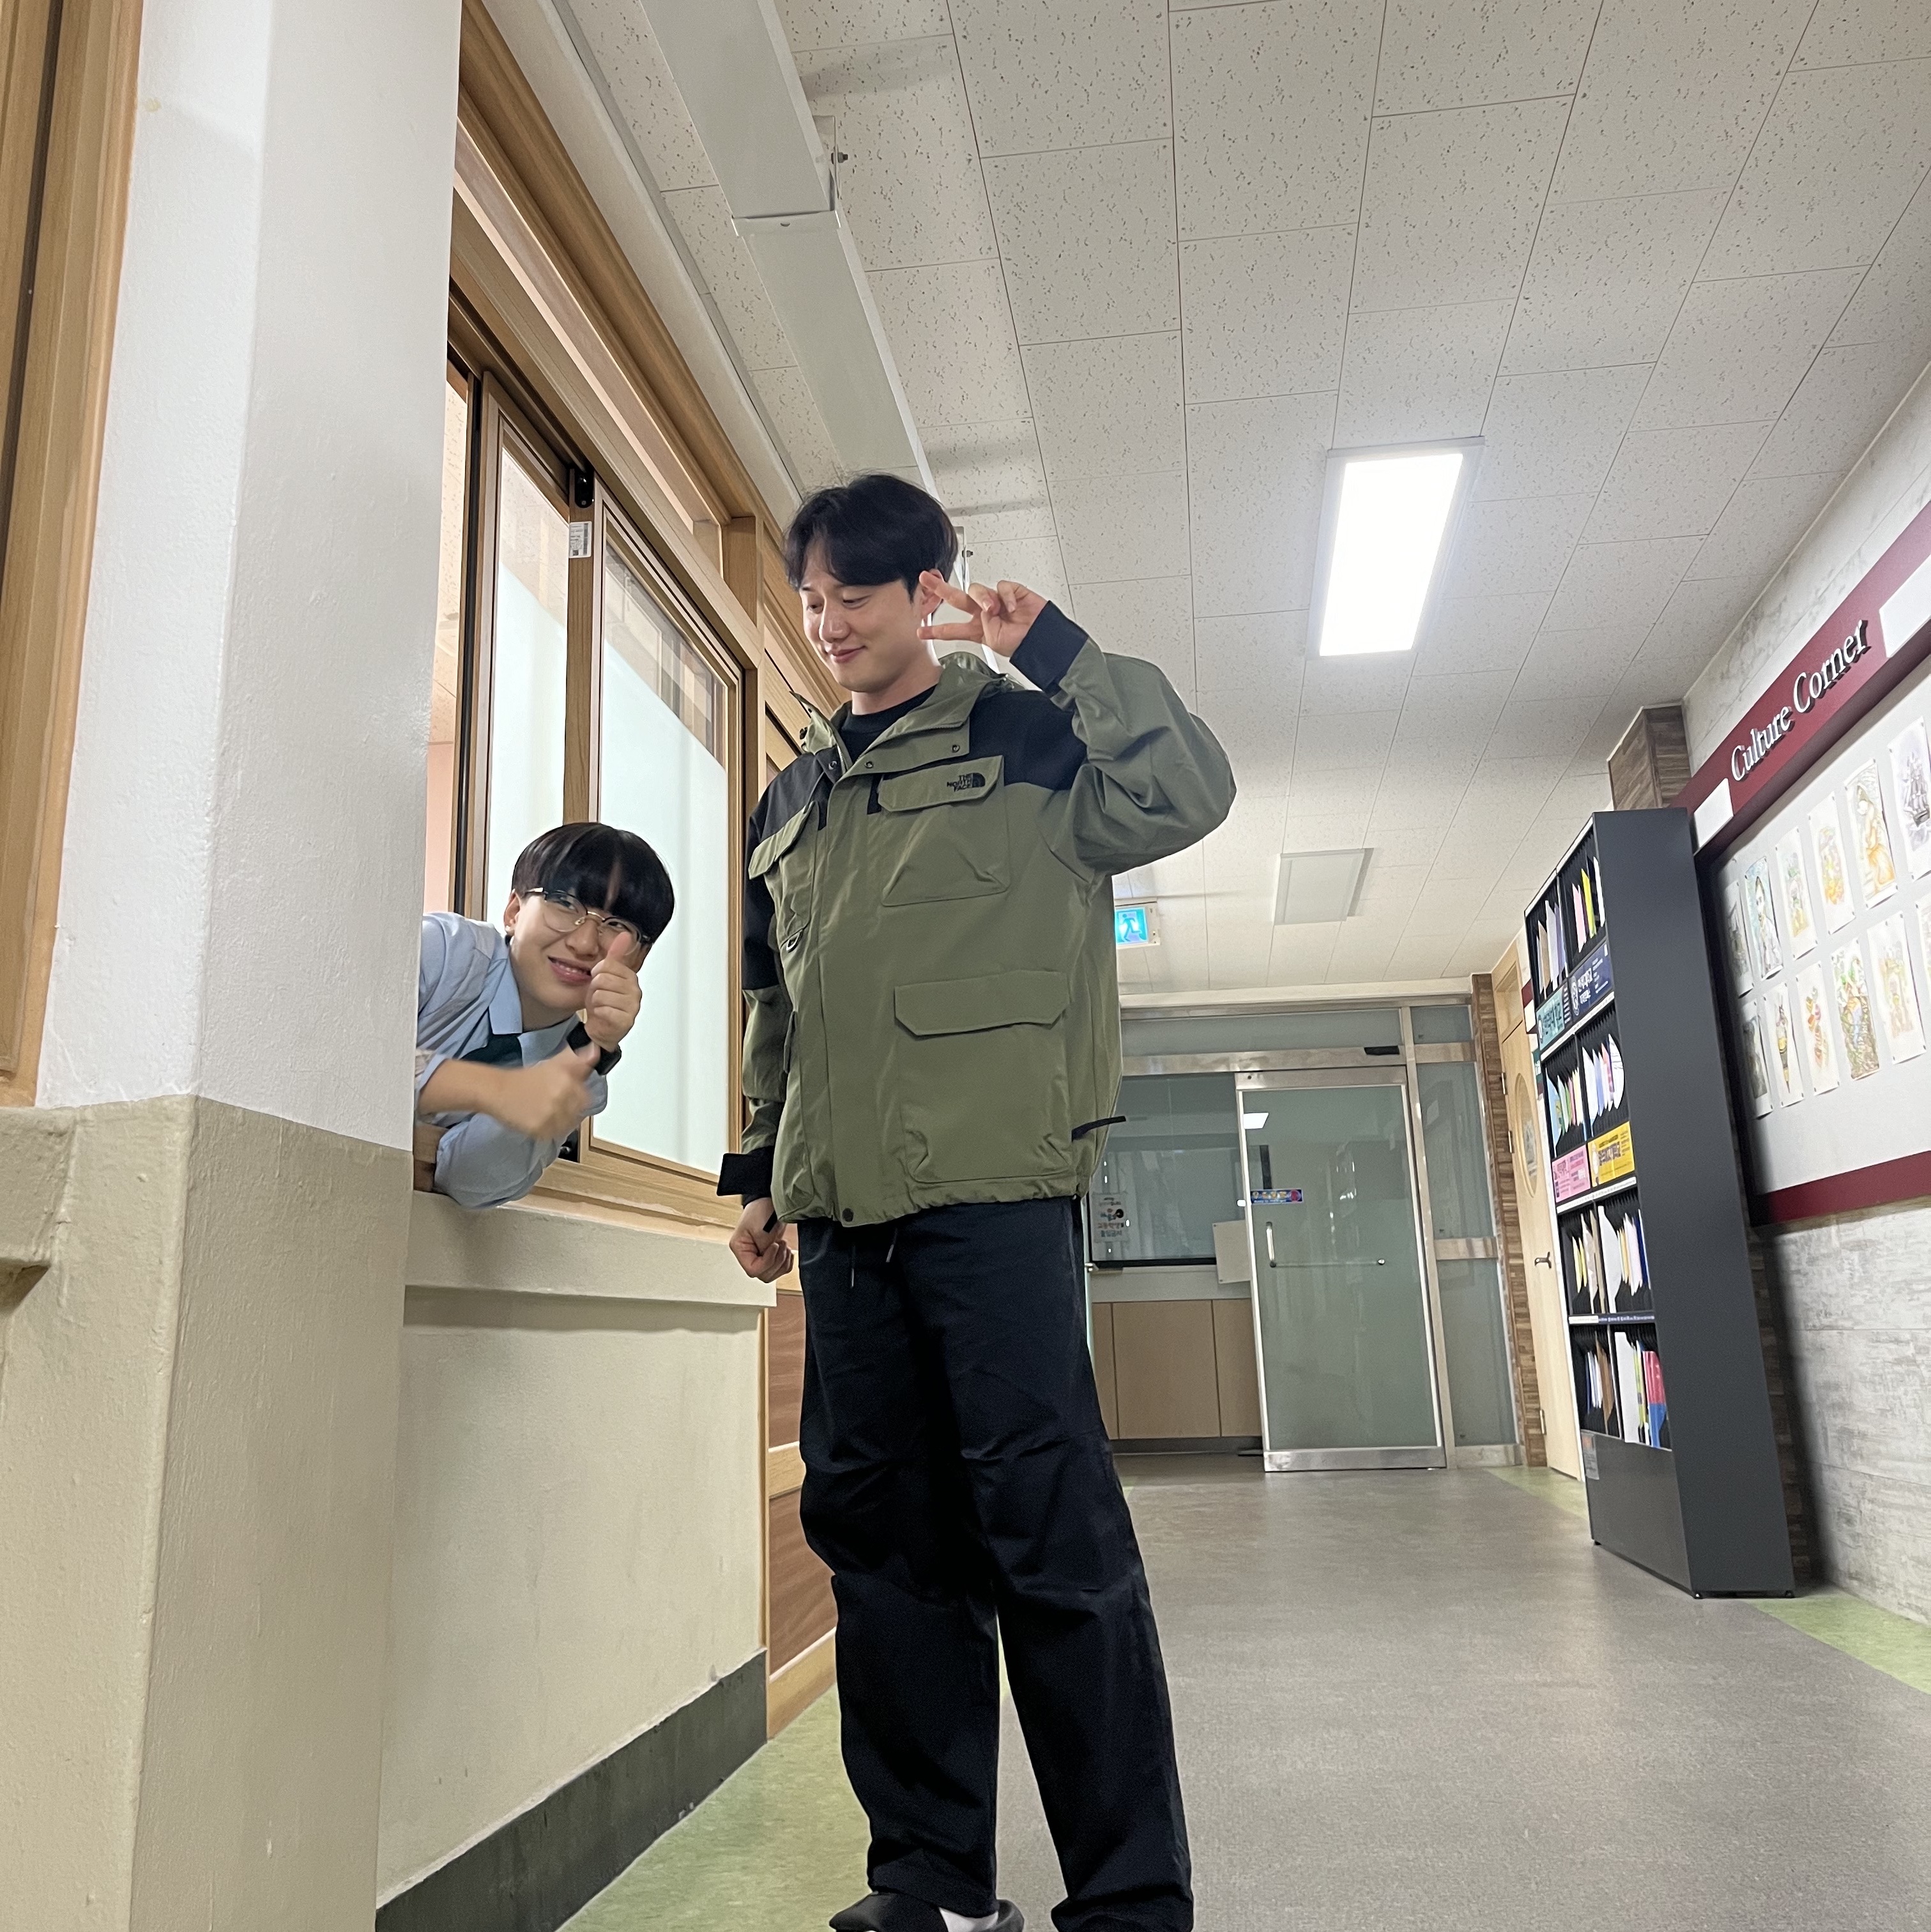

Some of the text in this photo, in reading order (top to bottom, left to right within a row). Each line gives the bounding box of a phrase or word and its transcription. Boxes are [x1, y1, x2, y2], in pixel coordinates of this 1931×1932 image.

[1730, 620, 1869, 782] Culture Corner
[947, 779, 972, 787] NORTH
